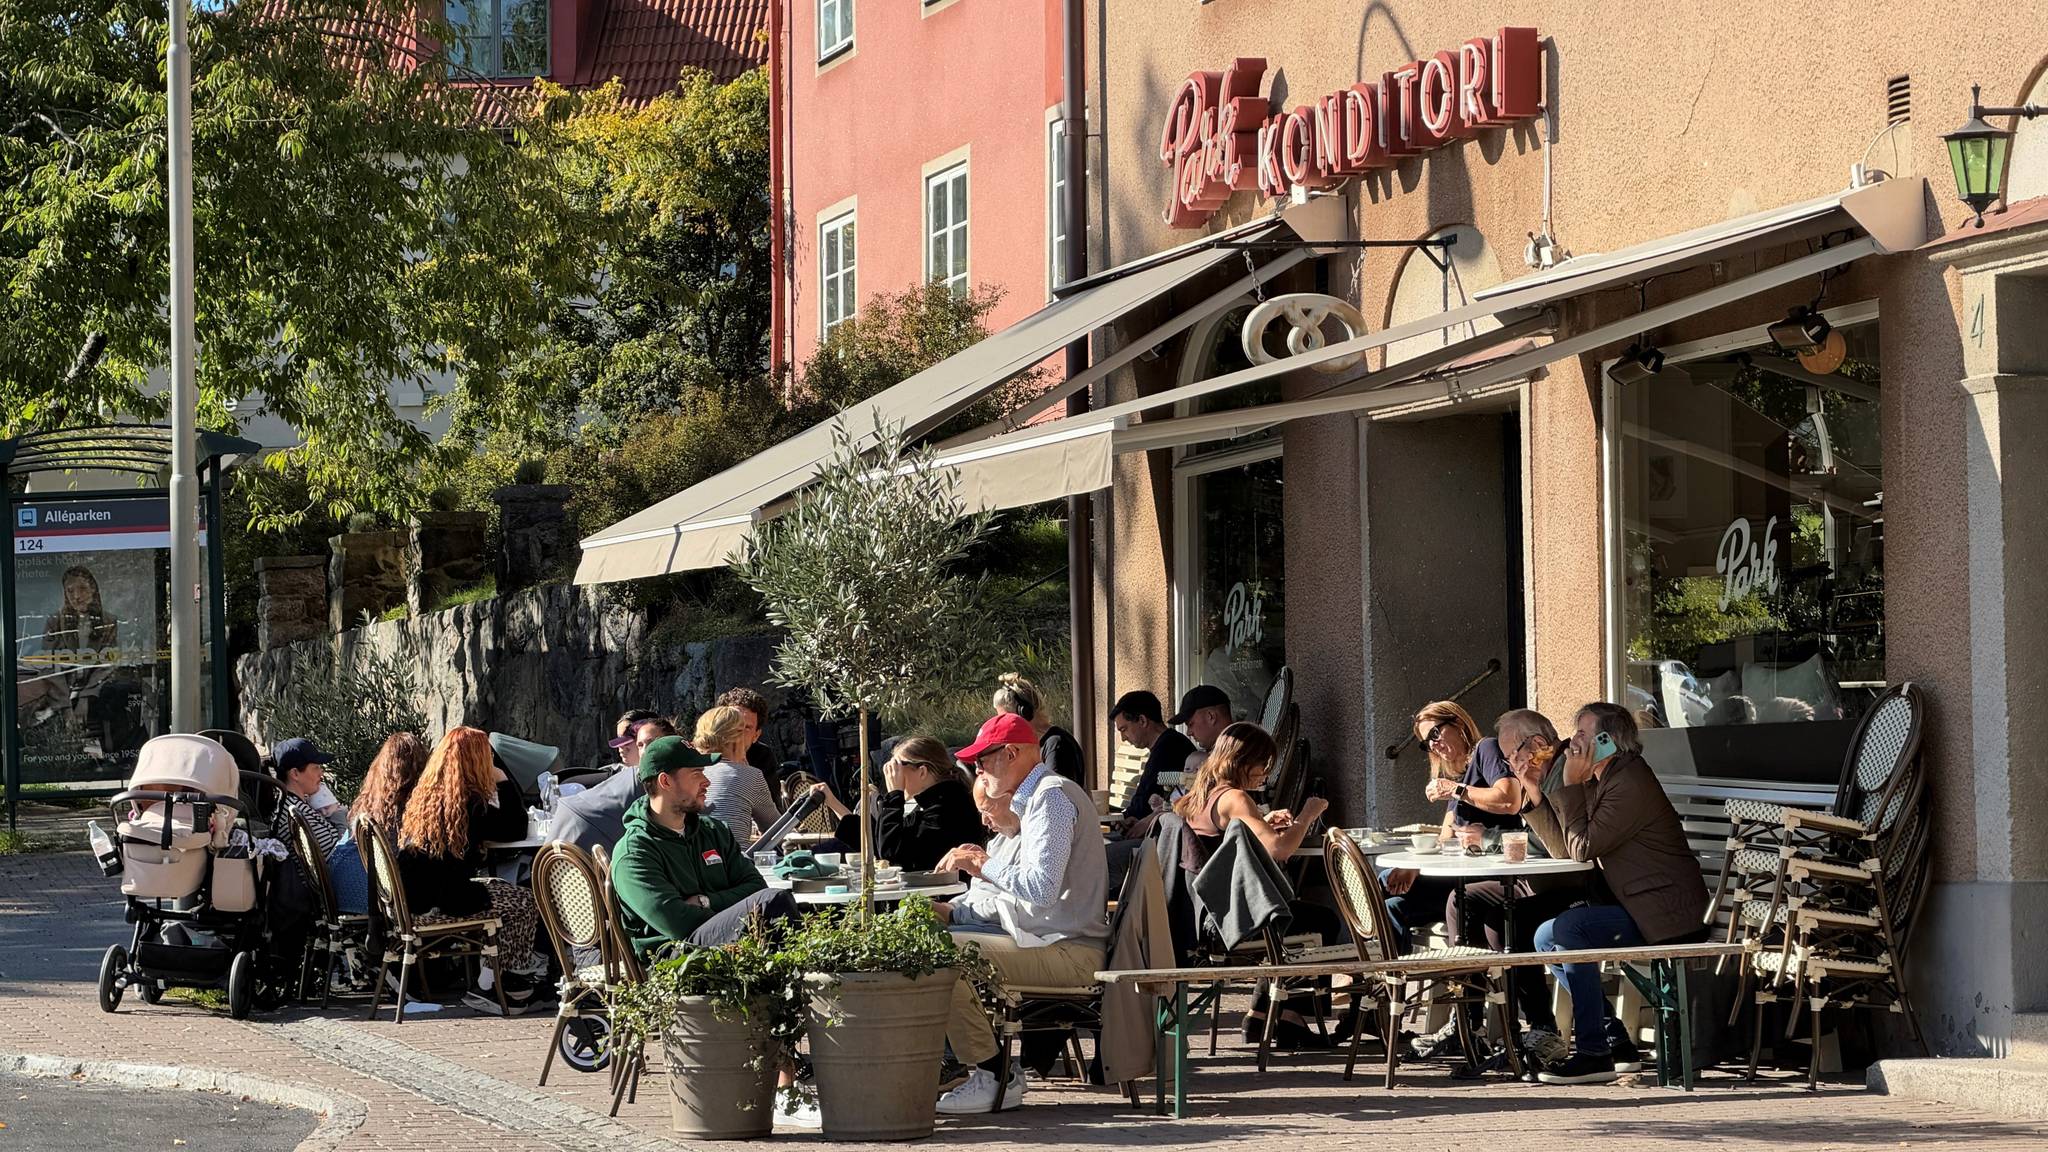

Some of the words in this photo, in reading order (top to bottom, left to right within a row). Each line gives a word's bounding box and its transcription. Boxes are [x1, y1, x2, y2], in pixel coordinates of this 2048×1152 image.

[1160, 58, 1264, 228] Park
[1258, 27, 1536, 198] KONDITORI
[1970, 293, 1985, 349] 4
[44, 509, 111, 524] Alléparken
[19, 539, 43, 551] 124
[15, 557, 50, 569] pptäck
[1716, 515, 1780, 612] Park
[1223, 581, 1264, 656] Park
[23, 754, 37, 763] For
[37, 755, 53, 764] you
[54, 753, 71, 761] and
